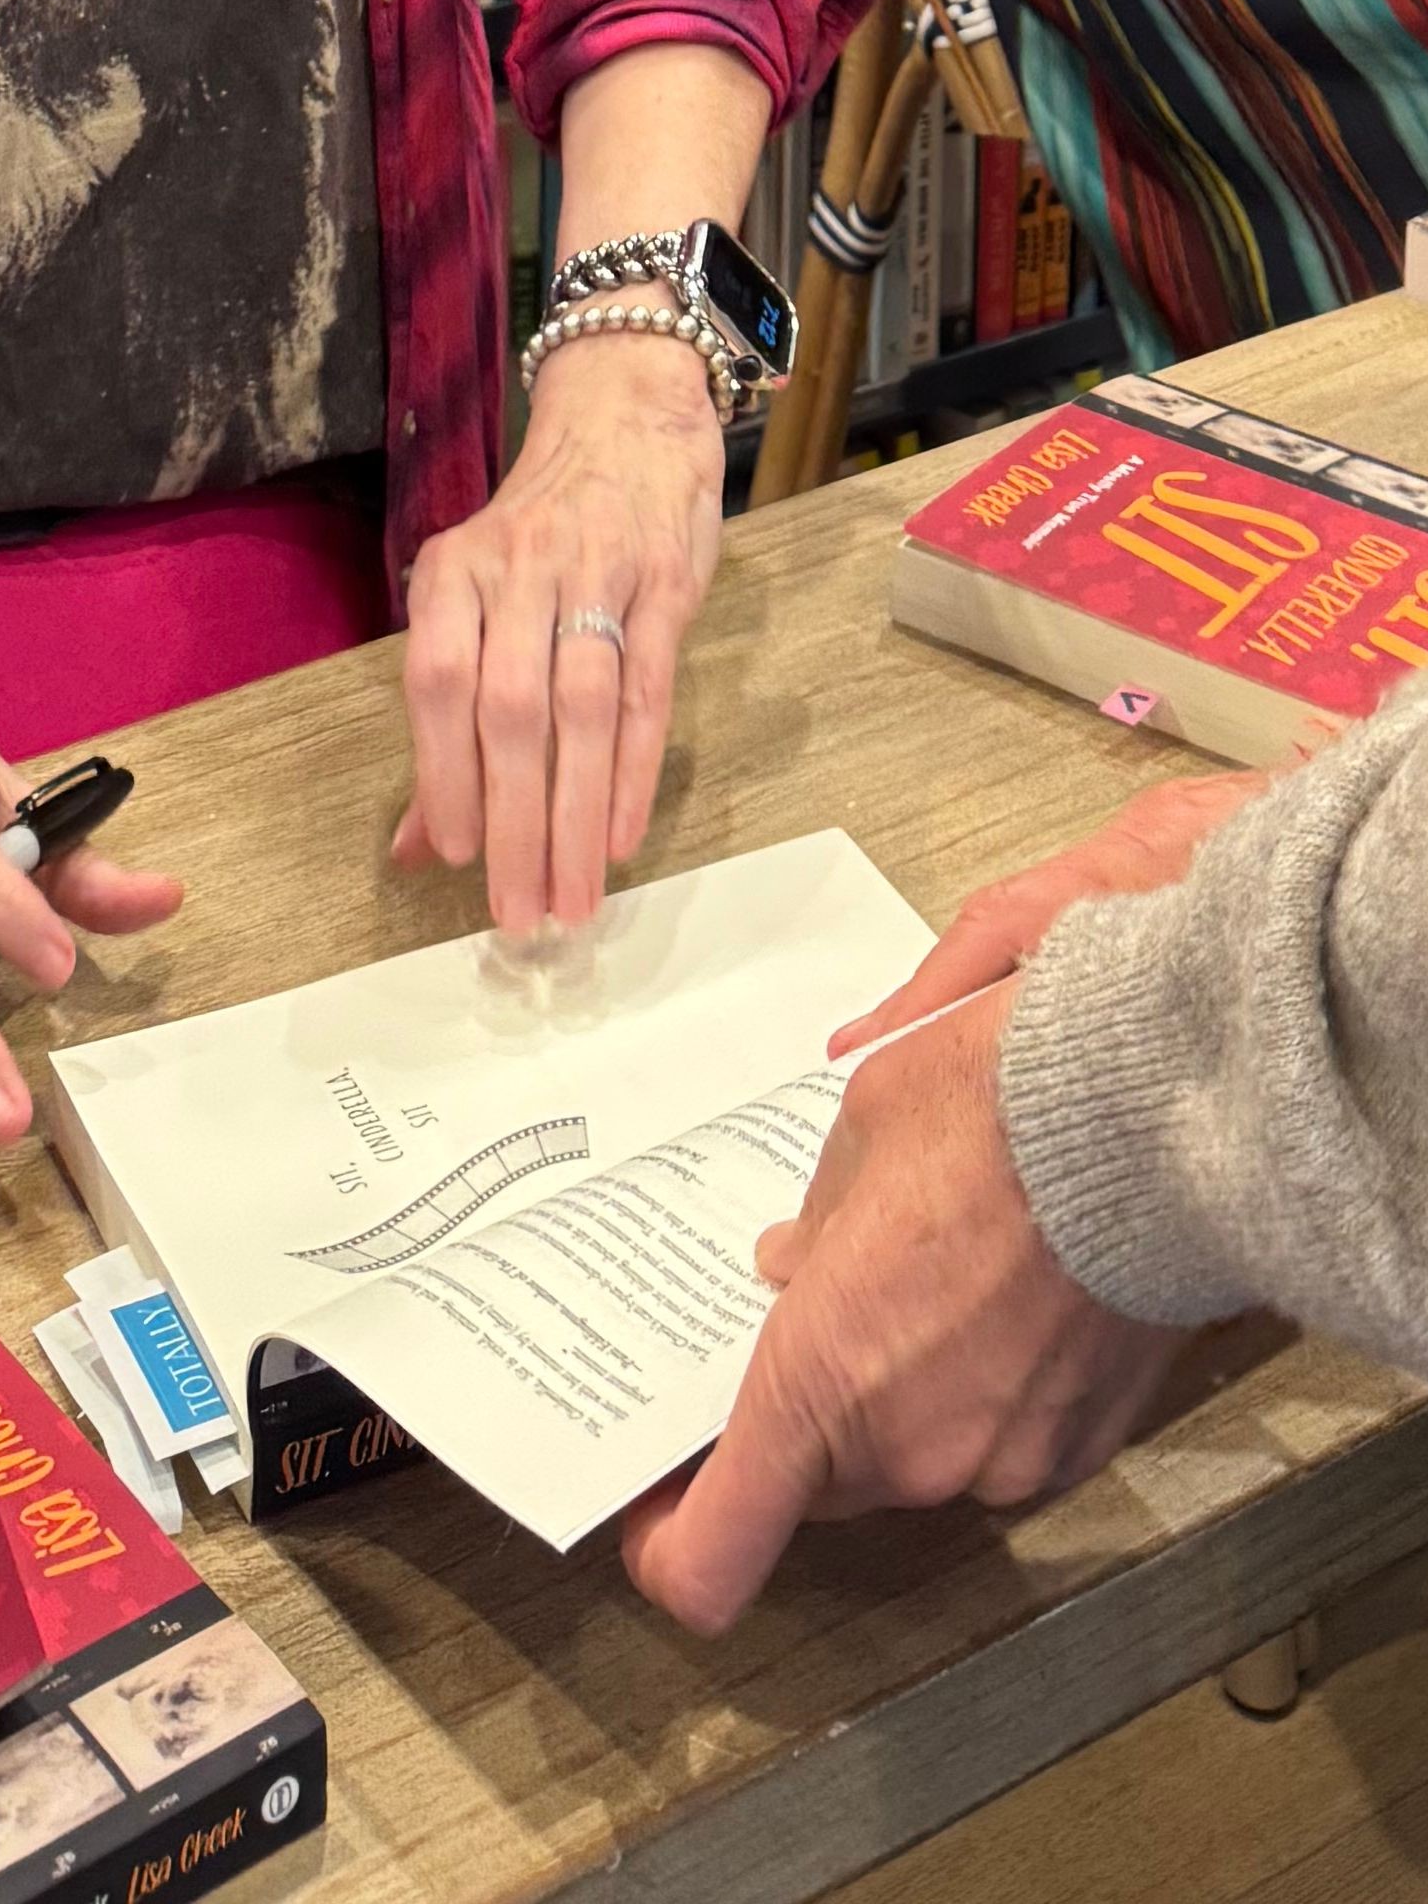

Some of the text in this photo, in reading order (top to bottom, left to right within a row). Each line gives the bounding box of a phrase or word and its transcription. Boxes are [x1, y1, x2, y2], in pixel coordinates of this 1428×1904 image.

[963, 429, 1100, 526] Lisa Cheek
[1022, 455, 1144, 550] A Mostly True Memoir
[1101, 469, 1322, 640] SIT
[401, 1104, 439, 1128] SIT
[137, 1304, 221, 1417] TOTALLY
[20, 1489, 127, 1577] Lisa
[126, 1807, 248, 1904] Lisa Cheek
